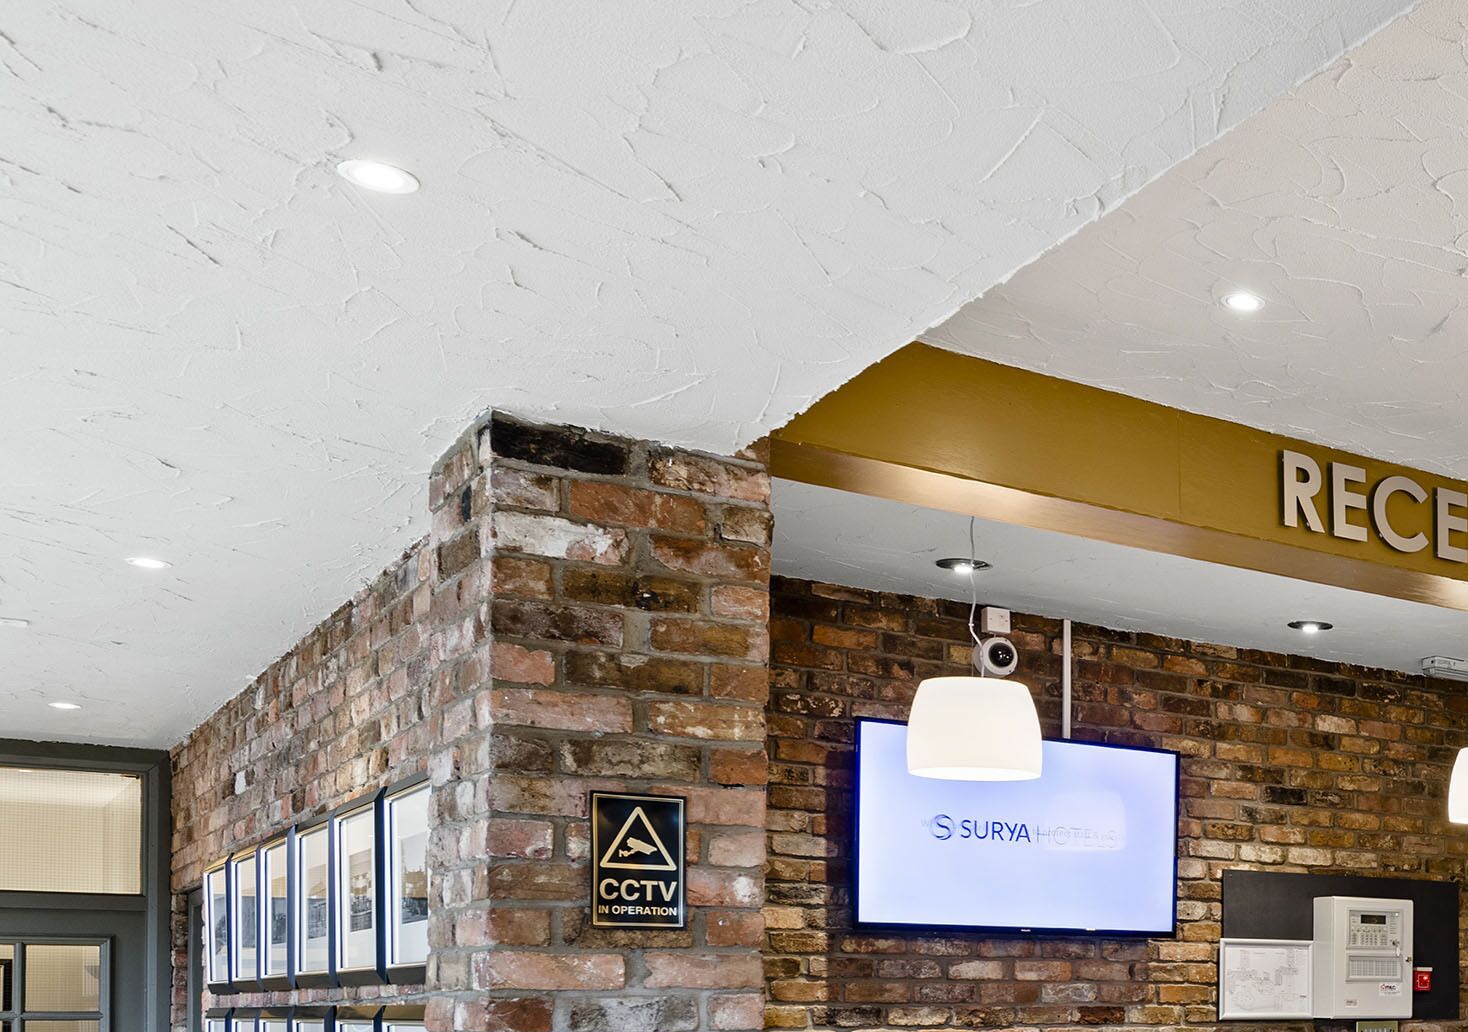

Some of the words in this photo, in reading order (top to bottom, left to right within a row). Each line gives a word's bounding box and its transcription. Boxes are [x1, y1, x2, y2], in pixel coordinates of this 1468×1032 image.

[960, 818, 1031, 843] SURYA
[599, 878, 678, 902] CCTV
[598, 905, 609, 914] IN
[612, 905, 678, 916] OPERATION
